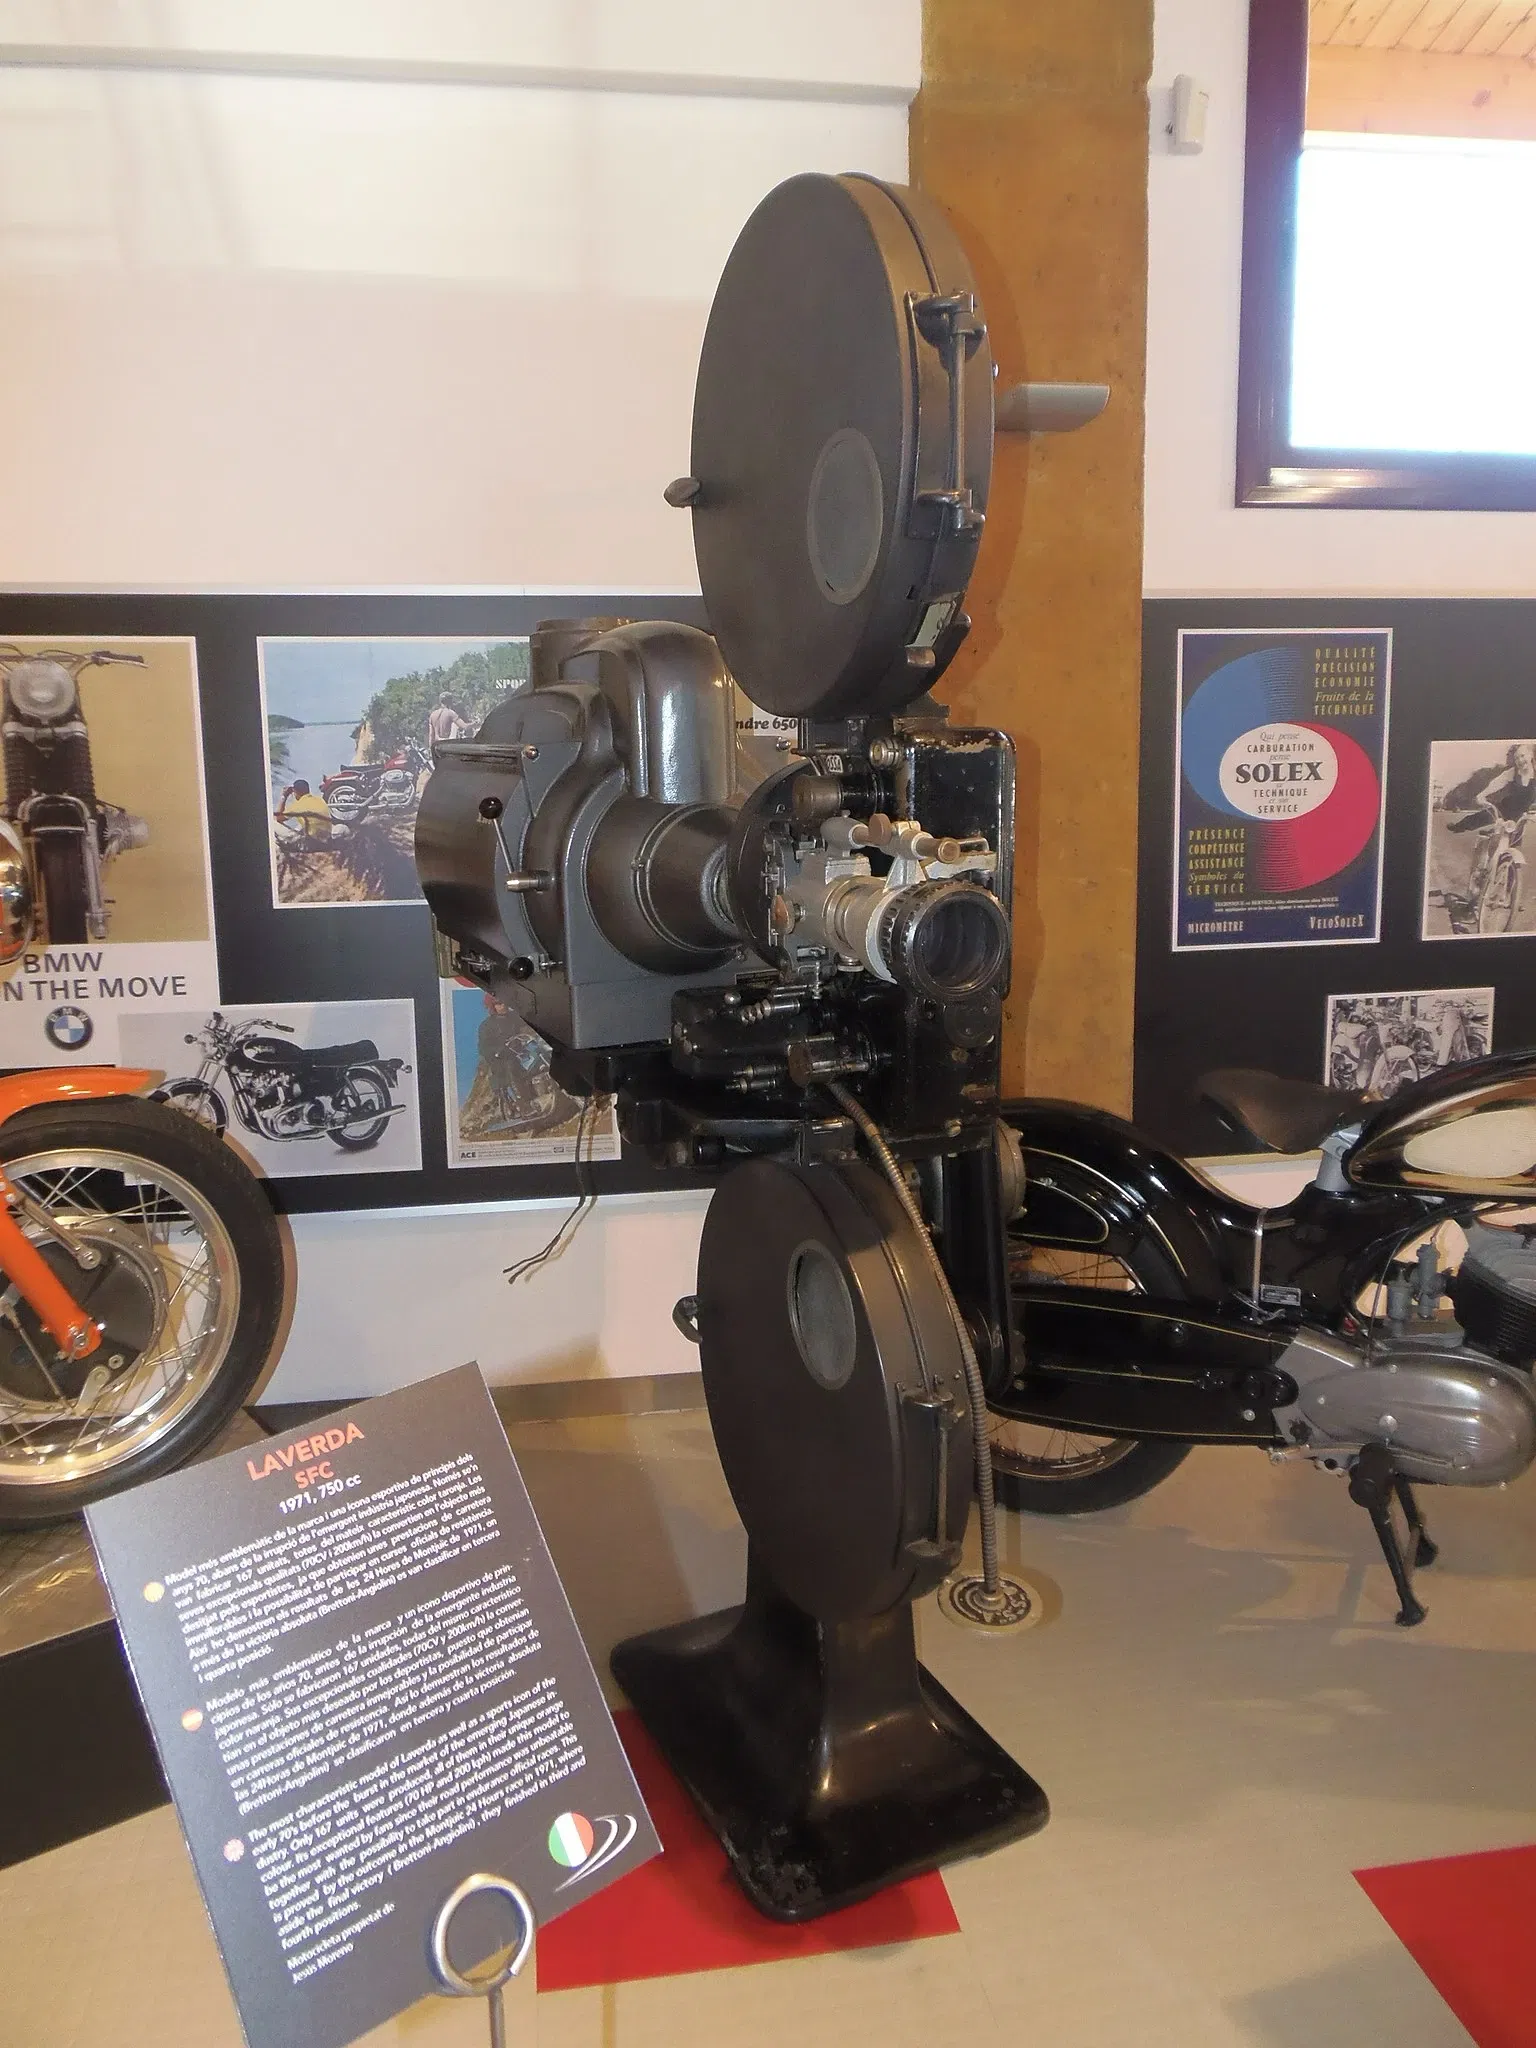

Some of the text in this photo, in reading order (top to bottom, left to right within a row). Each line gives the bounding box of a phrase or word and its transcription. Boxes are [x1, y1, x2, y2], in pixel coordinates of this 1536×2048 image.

[1315, 692, 1345, 702] Fruits
[1314, 704, 1374, 716] TECHNIQUE
[736, 717, 798, 731] ndre 650
[1247, 743, 1315, 753] CARBURATION
[1235, 762, 1324, 784] SOLEX
[1253, 788, 1308, 798] TECHNIQUE
[1258, 804, 1299, 814] SERVICE
[1188, 828, 1245, 841] PRÉSENCE
[1188, 842, 1245, 855] COMPÉTENCE
[1188, 857, 1245, 870] ASSISTANCE
[1187, 883, 1244, 896] SERVICE
[23, 952, 103, 974] BMW
[3, 976, 187, 1001] N THE MOVE
[247, 1422, 365, 1481] LAVERDA
[294, 1461, 334, 1489] SFC
[279, 1474, 361, 1513] 1971, 750 cc
[164, 1564, 197, 1585] Model
[273, 1530, 286, 1540] de
[286, 1526, 296, 1535] la
[296, 1515, 324, 1531] marca
[329, 1506, 346, 1517] una
[370, 1480, 409, 1500] esportiva
[409, 1474, 421, 1484] de
[421, 1460, 455, 1482] principis
[456, 1453, 473, 1465] dels
[174, 1596, 192, 1609] van
[195, 1579, 231, 1600] fabricar
[235, 1568, 252, 1582] 167
[256, 1556, 290, 1574] unitats,
[293, 1544, 317, 1559] totes
[320, 1534, 334, 1547] del
[335, 1524, 364, 1541] mateix
[416, 1493, 436, 1506] color
[467, 1474, 482, 1485] Les
[211, 1563, 239, 1580] abans
[239, 1557, 252, 1568] de
[252, 1553, 262, 1562] la
[298, 1533, 310, 1543] de
[310, 1513, 357, 1538] l'emergent
[205, 1688, 244, 1711] Modelo
[335, 1640, 348, 1651] de
[351, 1633, 361, 1643] la
[364, 1620, 391, 1637] marca
[396, 1614, 403, 1624] y
[404, 1608, 416, 1619] un
[441, 1578, 481, 1601] deportivo
[481, 1572, 493, 1582] de
[295, 1671, 341, 1698] fabricaron
[342, 1660, 358, 1675] 167
[360, 1644, 401, 1667] unidades,
[402, 1631, 426, 1647] todas
[427, 1621, 441, 1635] del
[441, 1610, 469, 1628] mismo
[203, 1661, 236, 1682] quarta
[247, 1676, 555, 1842] The most characteristic model of Laverda as well as a sports icon of the
[299, 1809, 331, 1831] before
[332, 1799, 349, 1813] the
[353, 1783, 378, 1802] burst
[379, 1779, 388, 1789] in
[389, 1770, 405, 1783] the
[406, 1751, 438, 1774] market
[439, 1743, 449, 1756] of
[450, 1738, 465, 1751] the
[466, 1716, 507, 1742] emerging
[508, 1696, 545, 1721] Japanese
[289, 1833, 313, 1850] Only
[314, 1821, 331, 1837] 167
[335, 1809, 359, 1826] units
[361, 1795, 384, 1812] were
[388, 1768, 432, 1801] produced,
[434, 1761, 444, 1775] all
[444, 1755, 454, 1768] of
[455, 1746, 477, 1762] them
[478, 1741, 487, 1750] in
[487, 1730, 506, 1745] their
[507, 1715, 535, 1734] unique
[535, 1700, 563, 1719] orange
[382, 1903, 394, 1915] de
[281, 1901, 358, 1950] fourth positions.
[316, 1942, 353, 1968] Moreno
